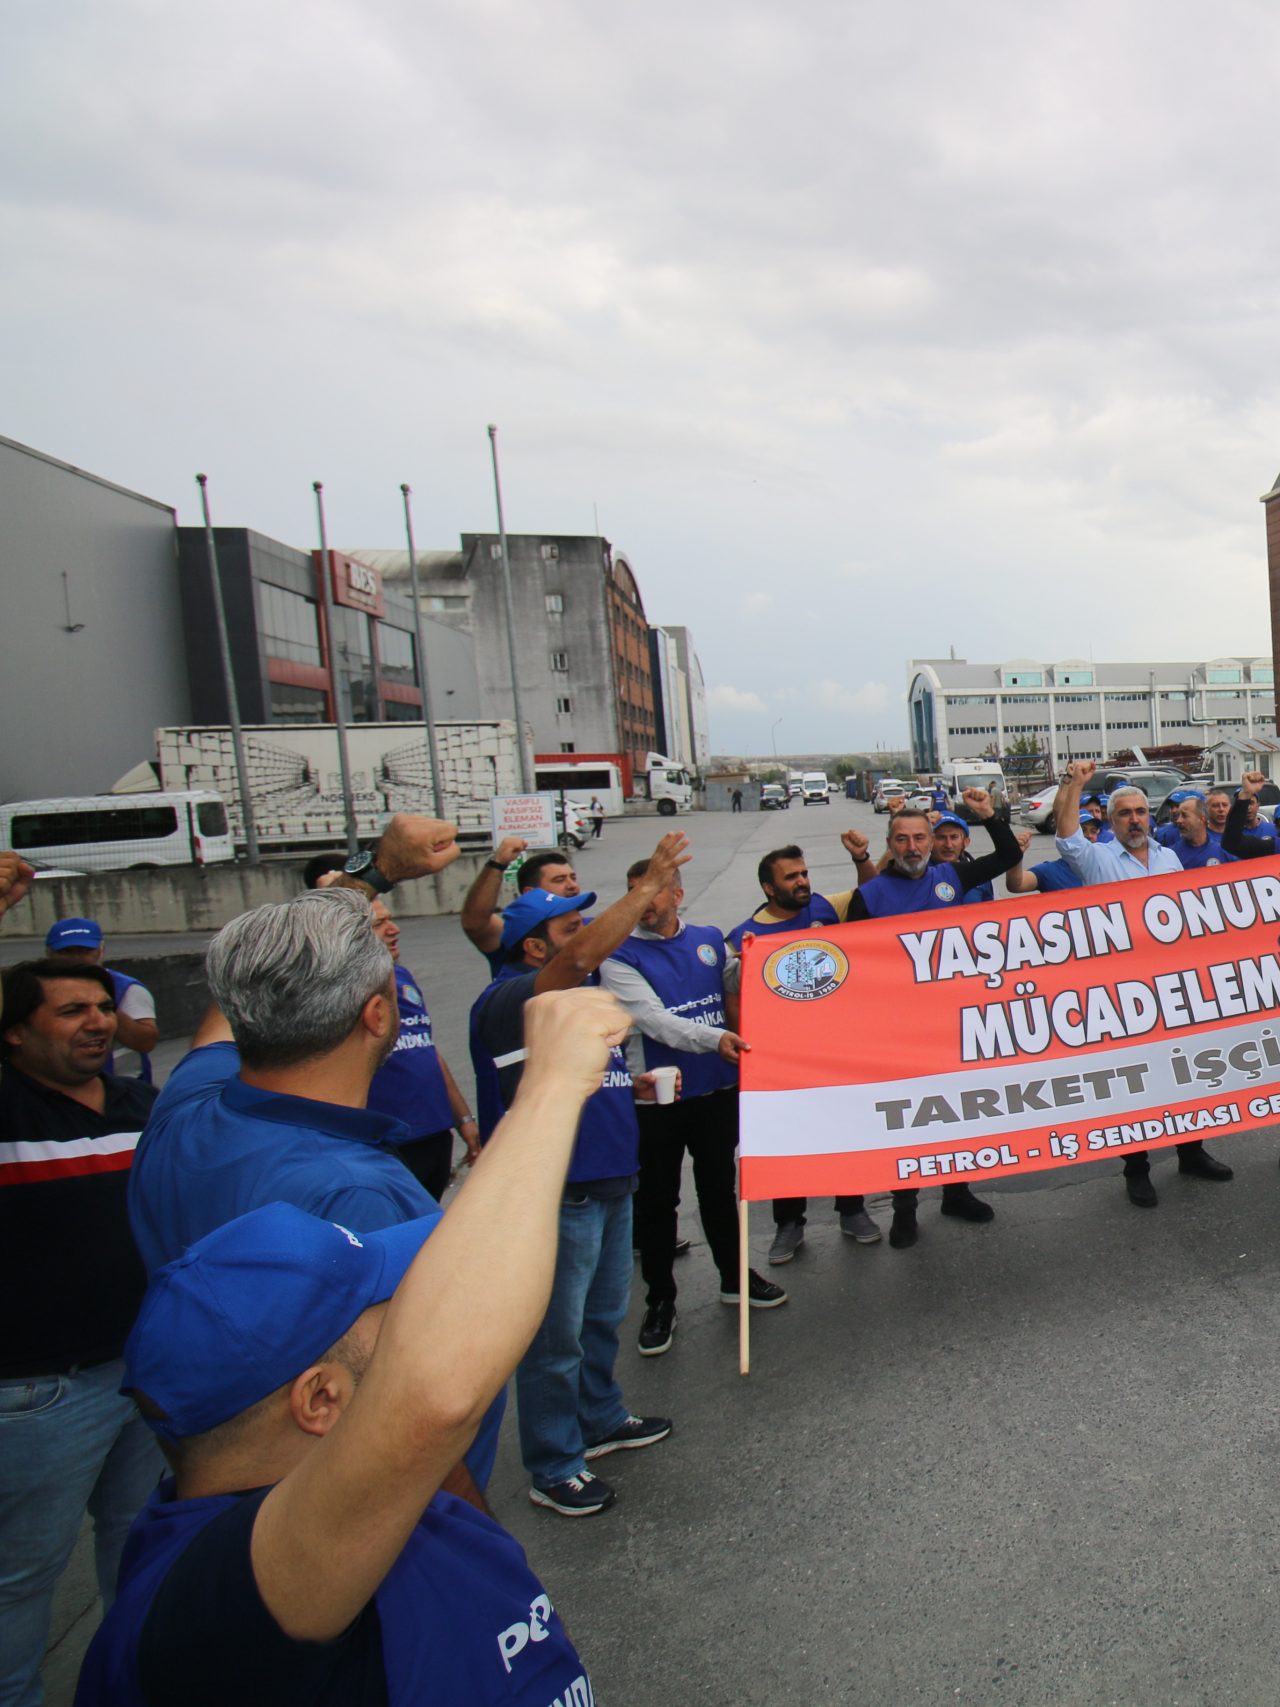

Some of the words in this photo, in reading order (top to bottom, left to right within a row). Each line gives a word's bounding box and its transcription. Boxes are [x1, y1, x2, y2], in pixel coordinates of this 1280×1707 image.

[899, 901, 1133, 989] YAŞASIN
[875, 1062, 1150, 1131] TARKETT
[897, 1144, 1019, 1180] PETROL
[1049, 1130, 1080, 1160] İŞ
[1087, 1105, 1240, 1151] SENDİKASI
